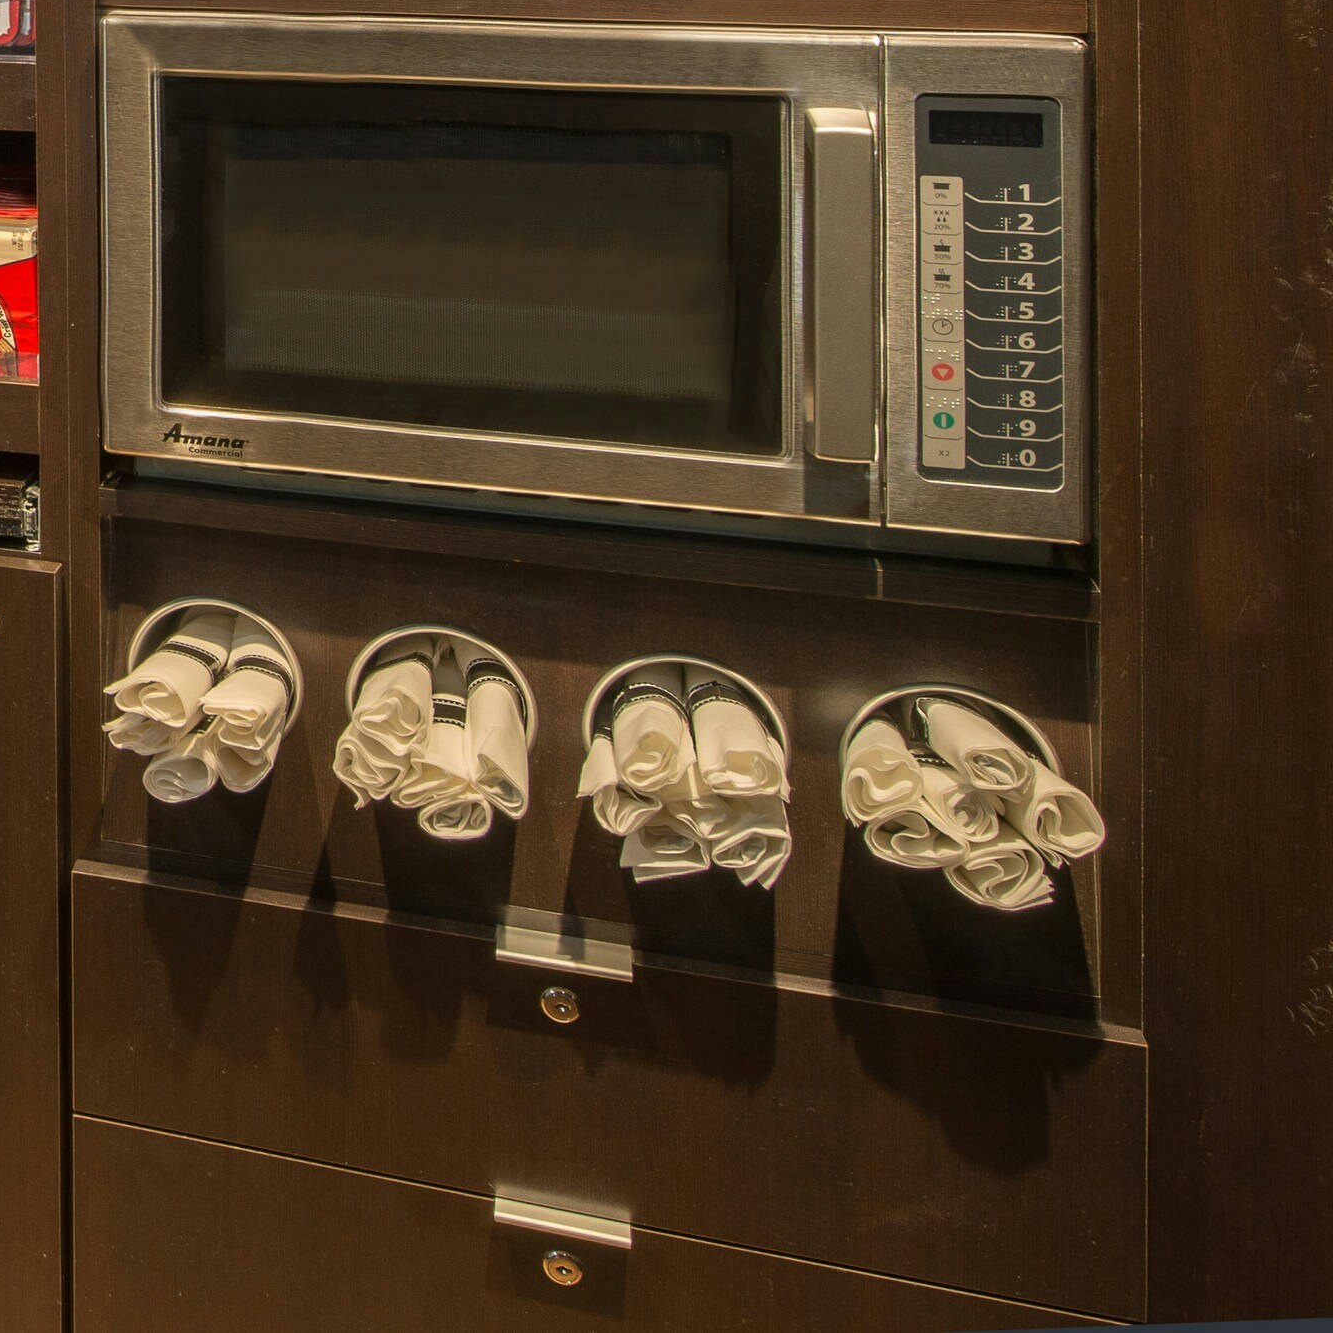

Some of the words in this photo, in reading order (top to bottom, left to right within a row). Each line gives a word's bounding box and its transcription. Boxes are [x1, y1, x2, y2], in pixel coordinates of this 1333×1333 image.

[935, 192, 948, 200] 0%
[1018, 184, 1032, 201] 1
[1017, 213, 1035, 231] 2
[934, 252, 952, 260] 50%
[1017, 243, 1035, 261] 3
[934, 282, 952, 290] 70%
[1016, 273, 1035, 290] 4
[1019, 302, 1035, 320] 5
[1018, 332, 1036, 350] 6
[1019, 361, 1036, 379] 7
[1019, 391, 1037, 408] 8
[163, 423, 245, 449] Amana
[1019, 420, 1037, 437] 9
[189, 447, 243, 458] Commercial
[1019, 450, 1037, 467] 0
